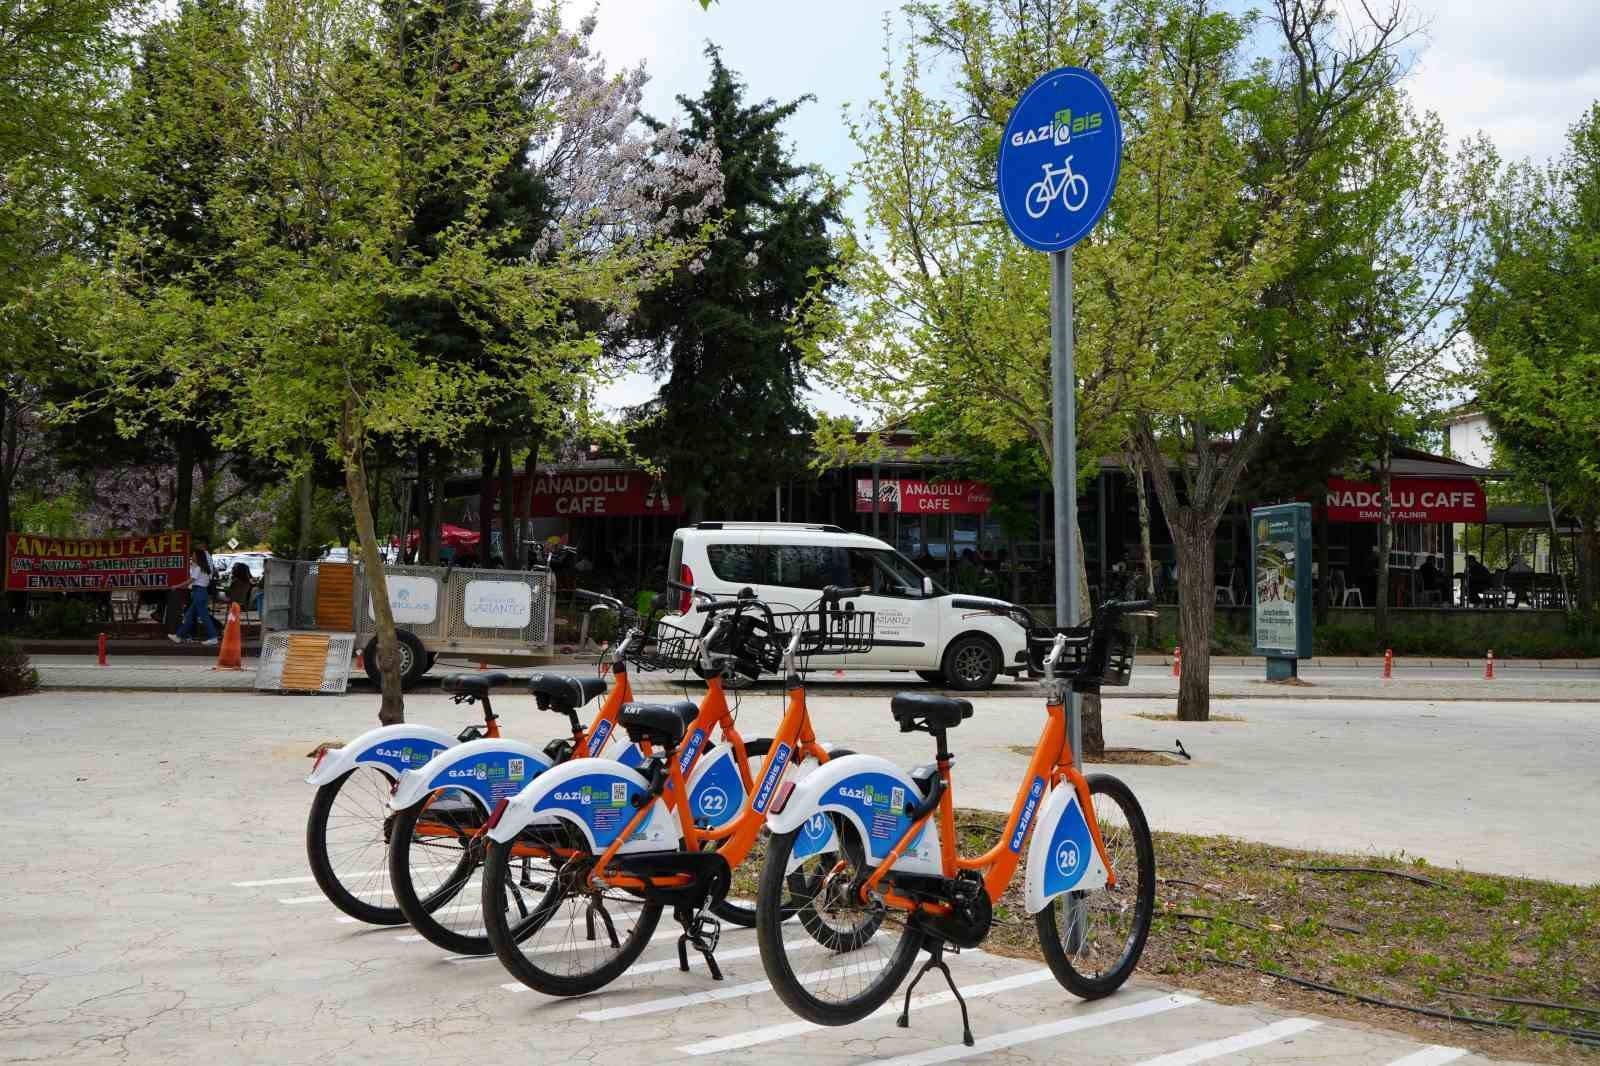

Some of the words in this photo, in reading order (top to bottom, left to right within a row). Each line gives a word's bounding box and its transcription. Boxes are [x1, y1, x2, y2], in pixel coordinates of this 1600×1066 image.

[534, 476, 629, 494] ANADOLU
[906, 484, 962, 496] ANADOLU
[556, 497, 606, 513] CAFE
[919, 499, 950, 510] CAFE
[1421, 492, 1476, 508] CAFE
[15, 537, 123, 557] ANADOLU
[129, 533, 183, 555] CAFE
[28, 575, 102, 588] EMANET
[703, 795, 723, 810] 22
[809, 815, 821, 832] 14
[1060, 851, 1076, 868] 28
